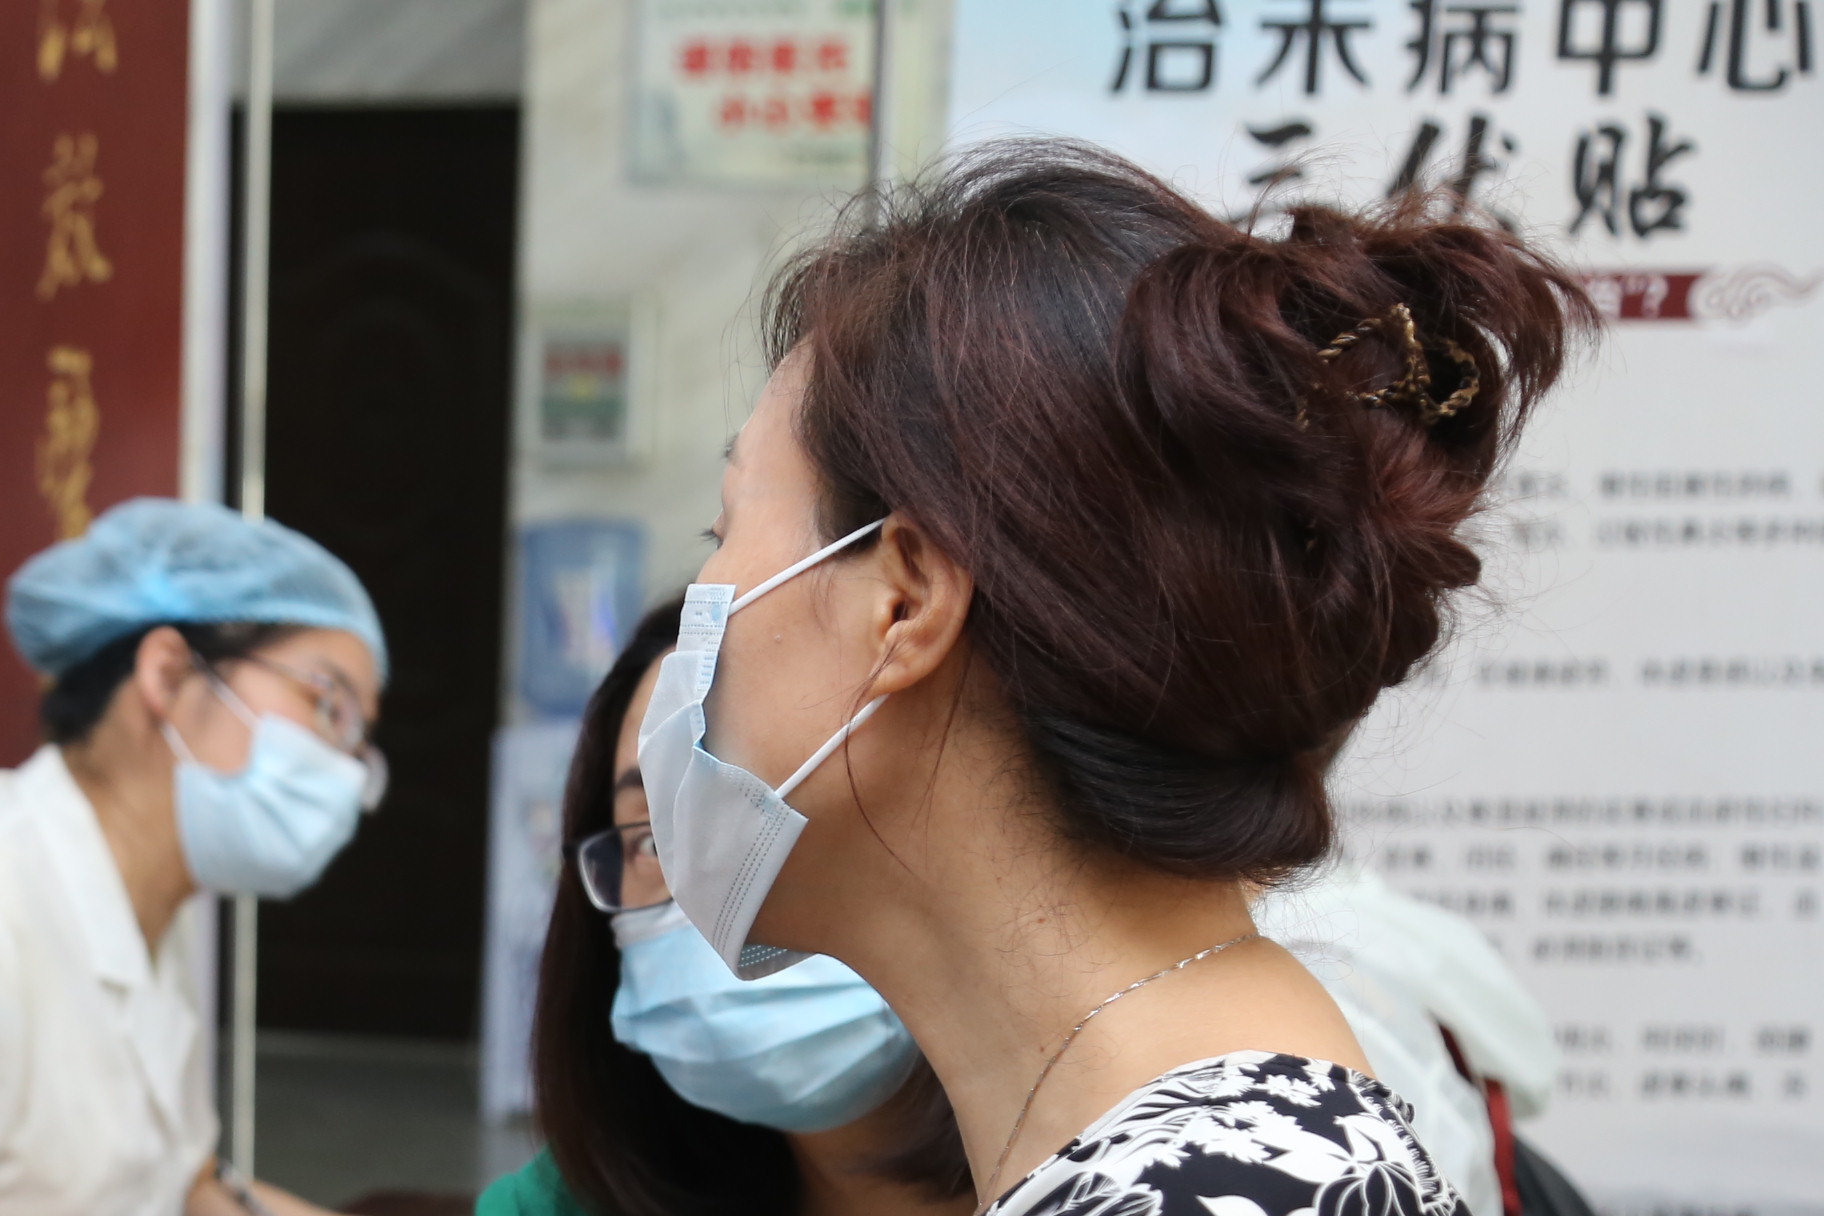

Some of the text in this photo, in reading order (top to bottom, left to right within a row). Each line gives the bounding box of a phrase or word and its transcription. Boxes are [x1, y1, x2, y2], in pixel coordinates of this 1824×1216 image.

[1110, 0, 1816, 96] 治未病中心
